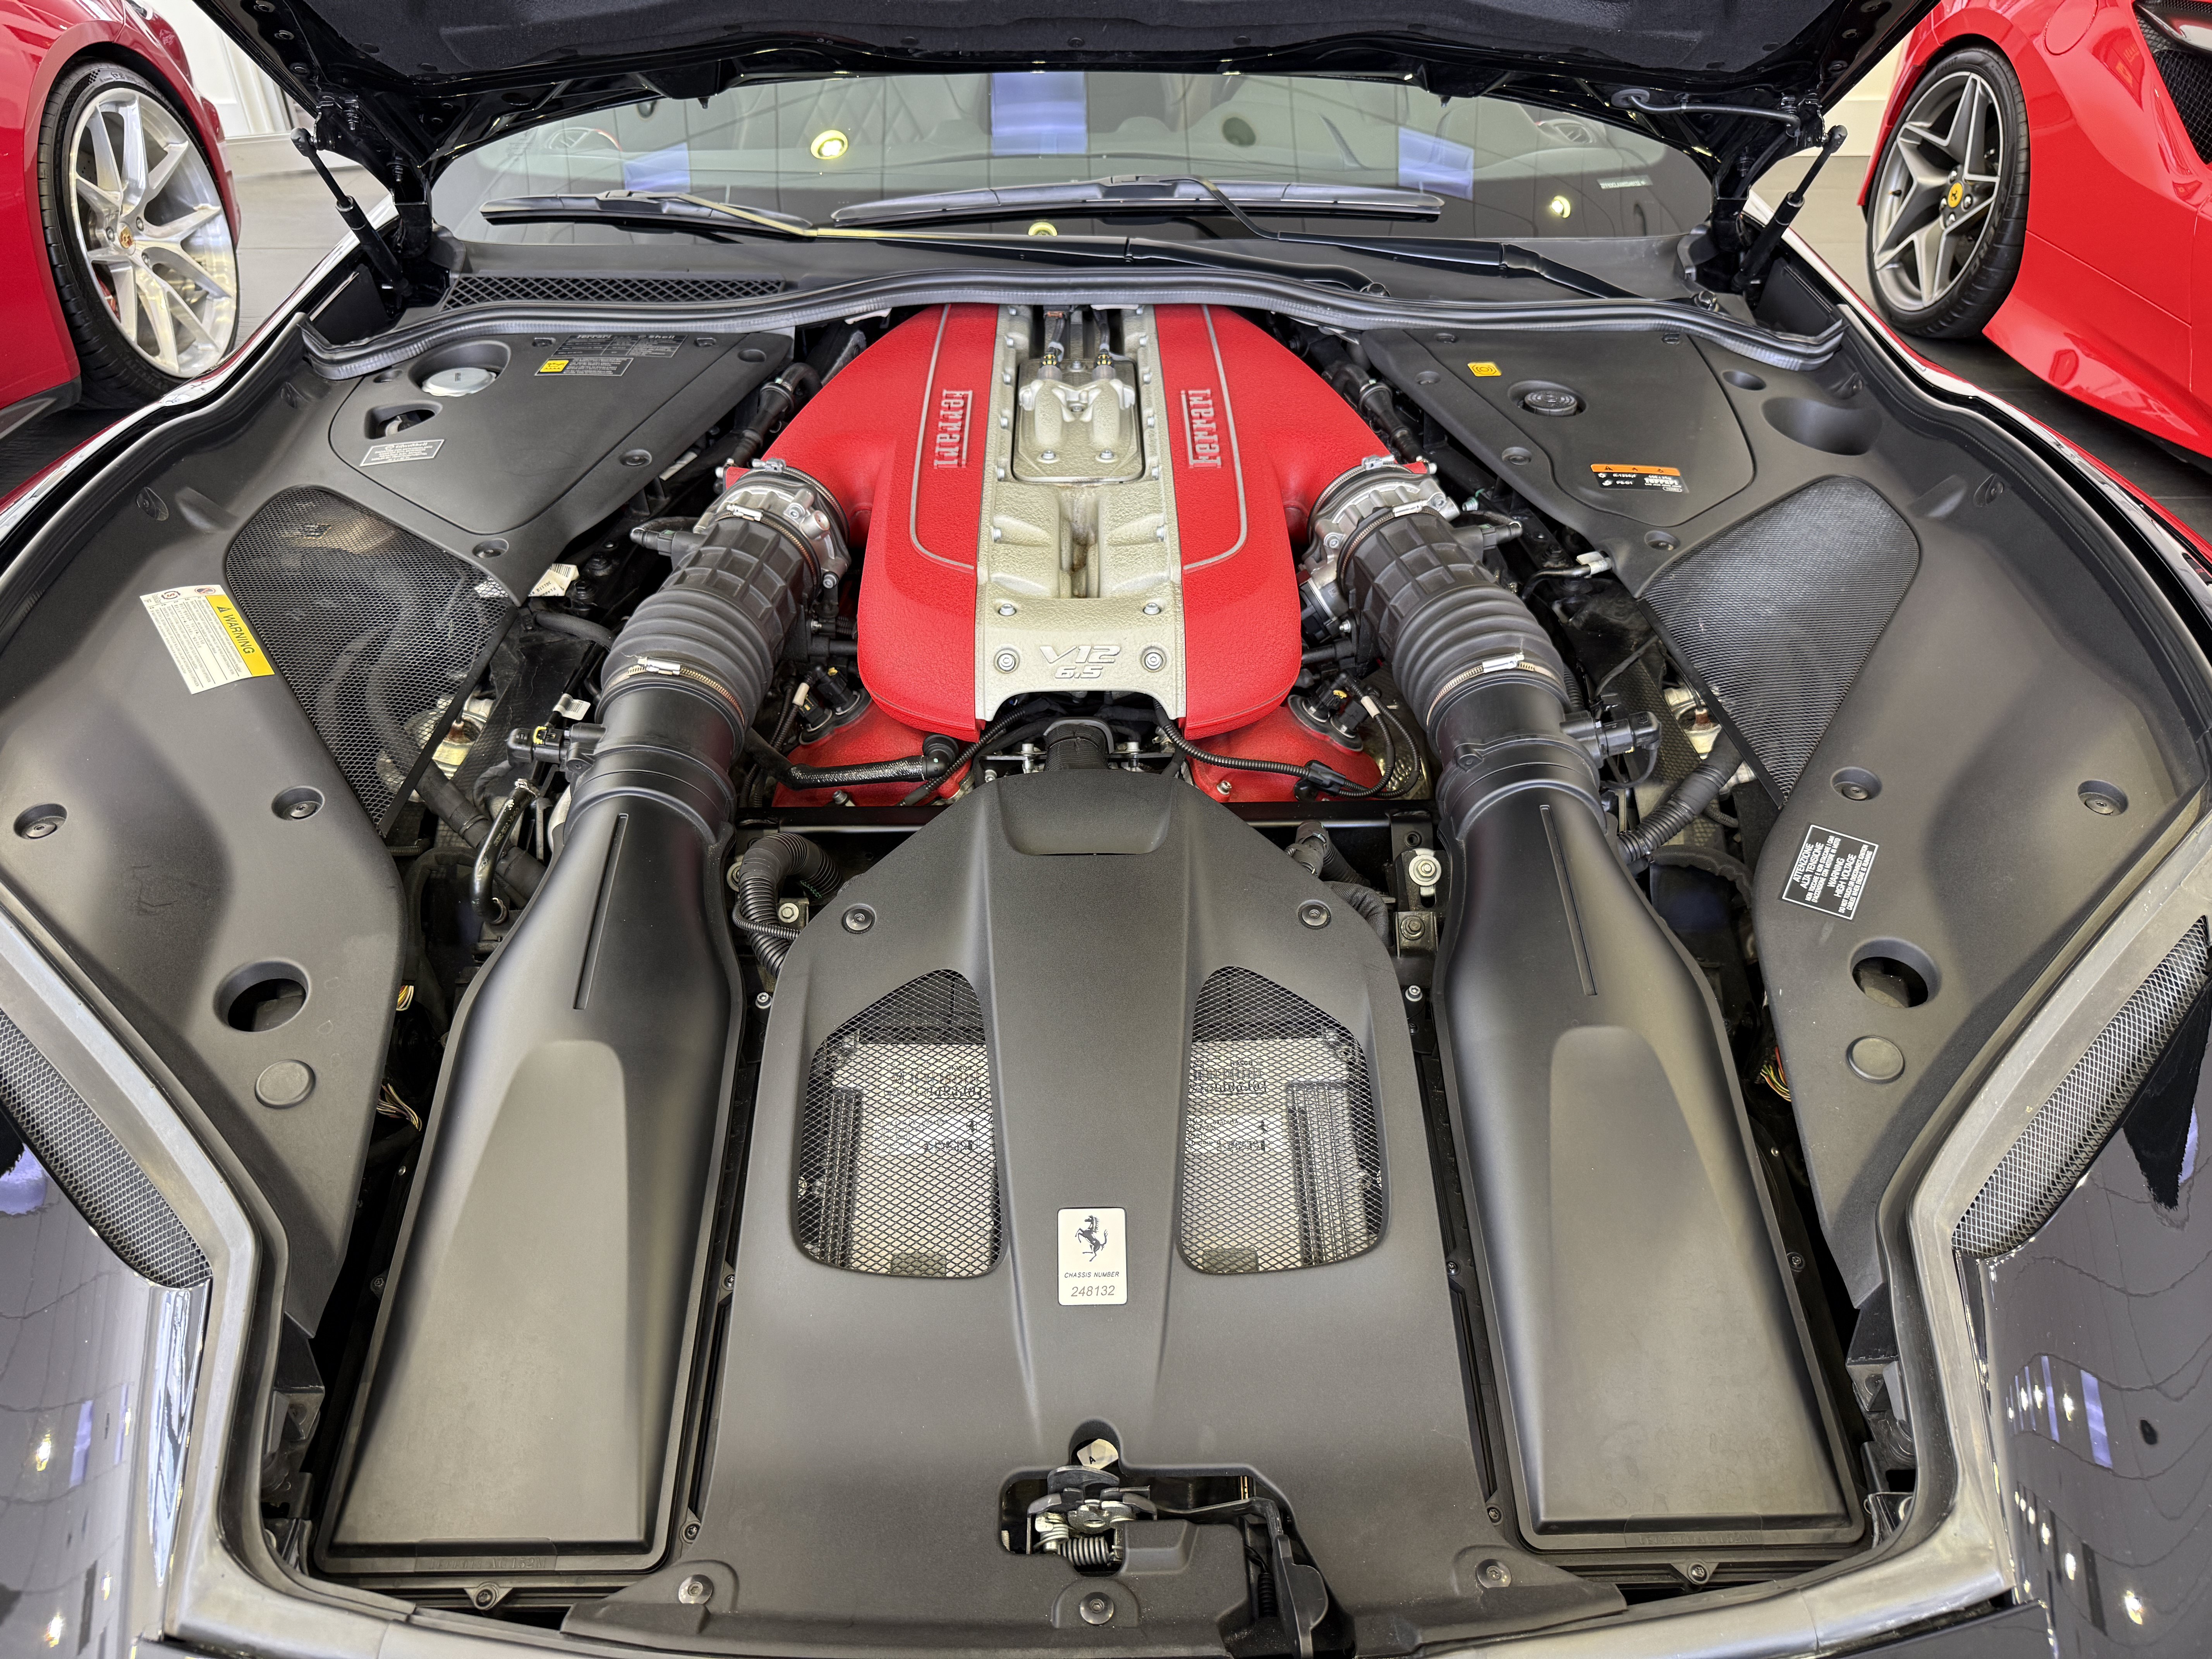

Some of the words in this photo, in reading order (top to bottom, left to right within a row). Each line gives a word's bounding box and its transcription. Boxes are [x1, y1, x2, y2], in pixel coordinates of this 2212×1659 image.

[933, 389, 973, 470] Ferrari
[1180, 388, 1222, 469] Ferrari
[223, 614, 255, 654] WARNING
[1039, 645, 1121, 665] V12
[1054, 665, 1103, 679] 6.5
[1792, 843, 1813, 882] ATTENZIONE
[1805, 842, 1824, 873] TENSIONE
[1825, 853, 1834, 868] MOTORE
[1832, 838, 1840, 848] MOTO
[1800, 873, 1812, 888] ALTA
[1808, 875, 1819, 892] TOCCARE
[1820, 846, 1830, 864] STACCARE
[1827, 857, 1844, 888] WARNING
[1834, 881, 1846, 897] HIGH
[1840, 853, 1856, 881] VOLTAGE
[1843, 886, 1852, 899] TOUCH
[1850, 859, 1862, 881] DISCONNECT
[1858, 844, 1868, 860] IGNITION
[1846, 896, 1856, 910] CABLES
[1851, 884, 1860, 896] WHEN
[1071, 1285, 1115, 1297] 248132
[1089, 1456, 1096, 1465] A
